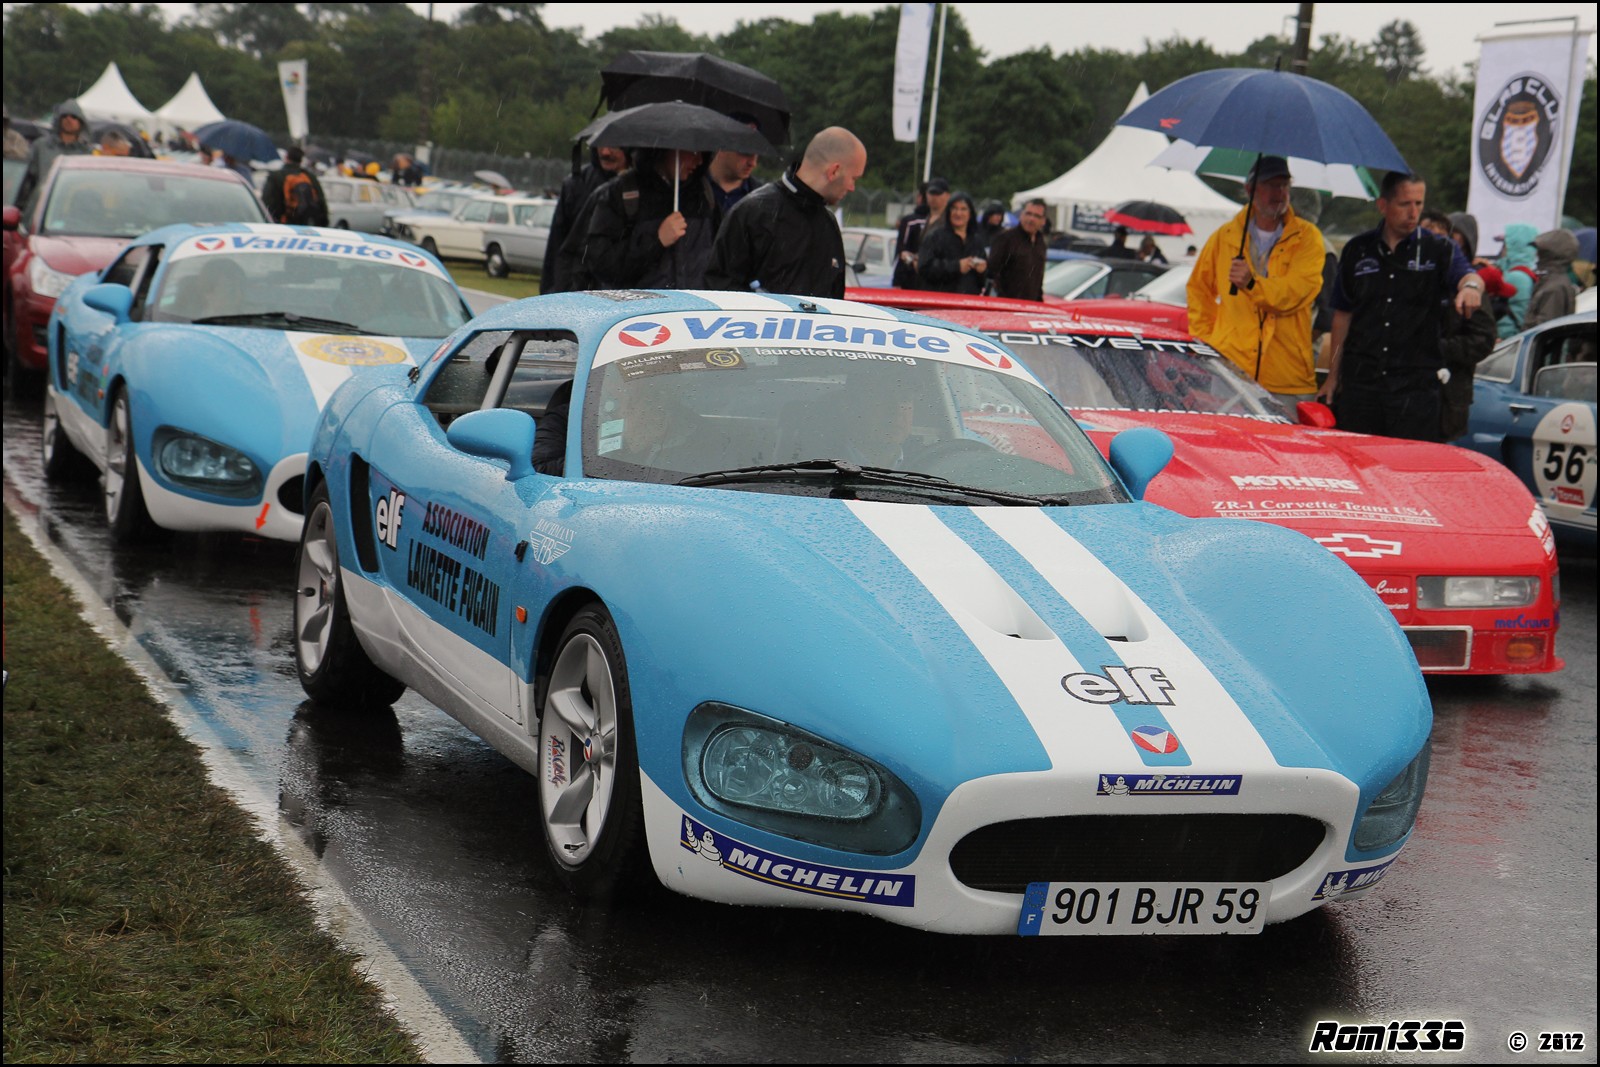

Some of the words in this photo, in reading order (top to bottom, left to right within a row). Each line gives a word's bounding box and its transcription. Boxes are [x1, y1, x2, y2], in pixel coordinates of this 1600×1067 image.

[231, 236, 393, 260] Vaillante
[683, 317, 951, 353] Vaillante
[620, 354, 673, 367] VAILLANTE
[755, 346, 917, 366] laurettefugain.org
[1543, 443, 1587, 484] 56
[1229, 475, 1361, 491] MOTHERS
[375, 487, 407, 552] elf
[1212, 500, 1254, 510] ZR-1
[1260, 501, 1338, 511] Corvette
[1340, 501, 1389, 514] Team
[1393, 507, 1433, 518] USA
[421, 501, 490, 561] ASSOCIATION
[407, 538, 461, 612] LAURETTE
[459, 566, 500, 637] FUGAIN
[1060, 665, 1177, 706] elf
[1134, 778, 1236, 790] MICHELIN
[728, 847, 903, 897] MICHELIN
[1026, 914, 1036, 924] F
[1051, 887, 1120, 925] 901
[1131, 887, 1205, 925] BJR
[1212, 887, 1260, 925] 59
